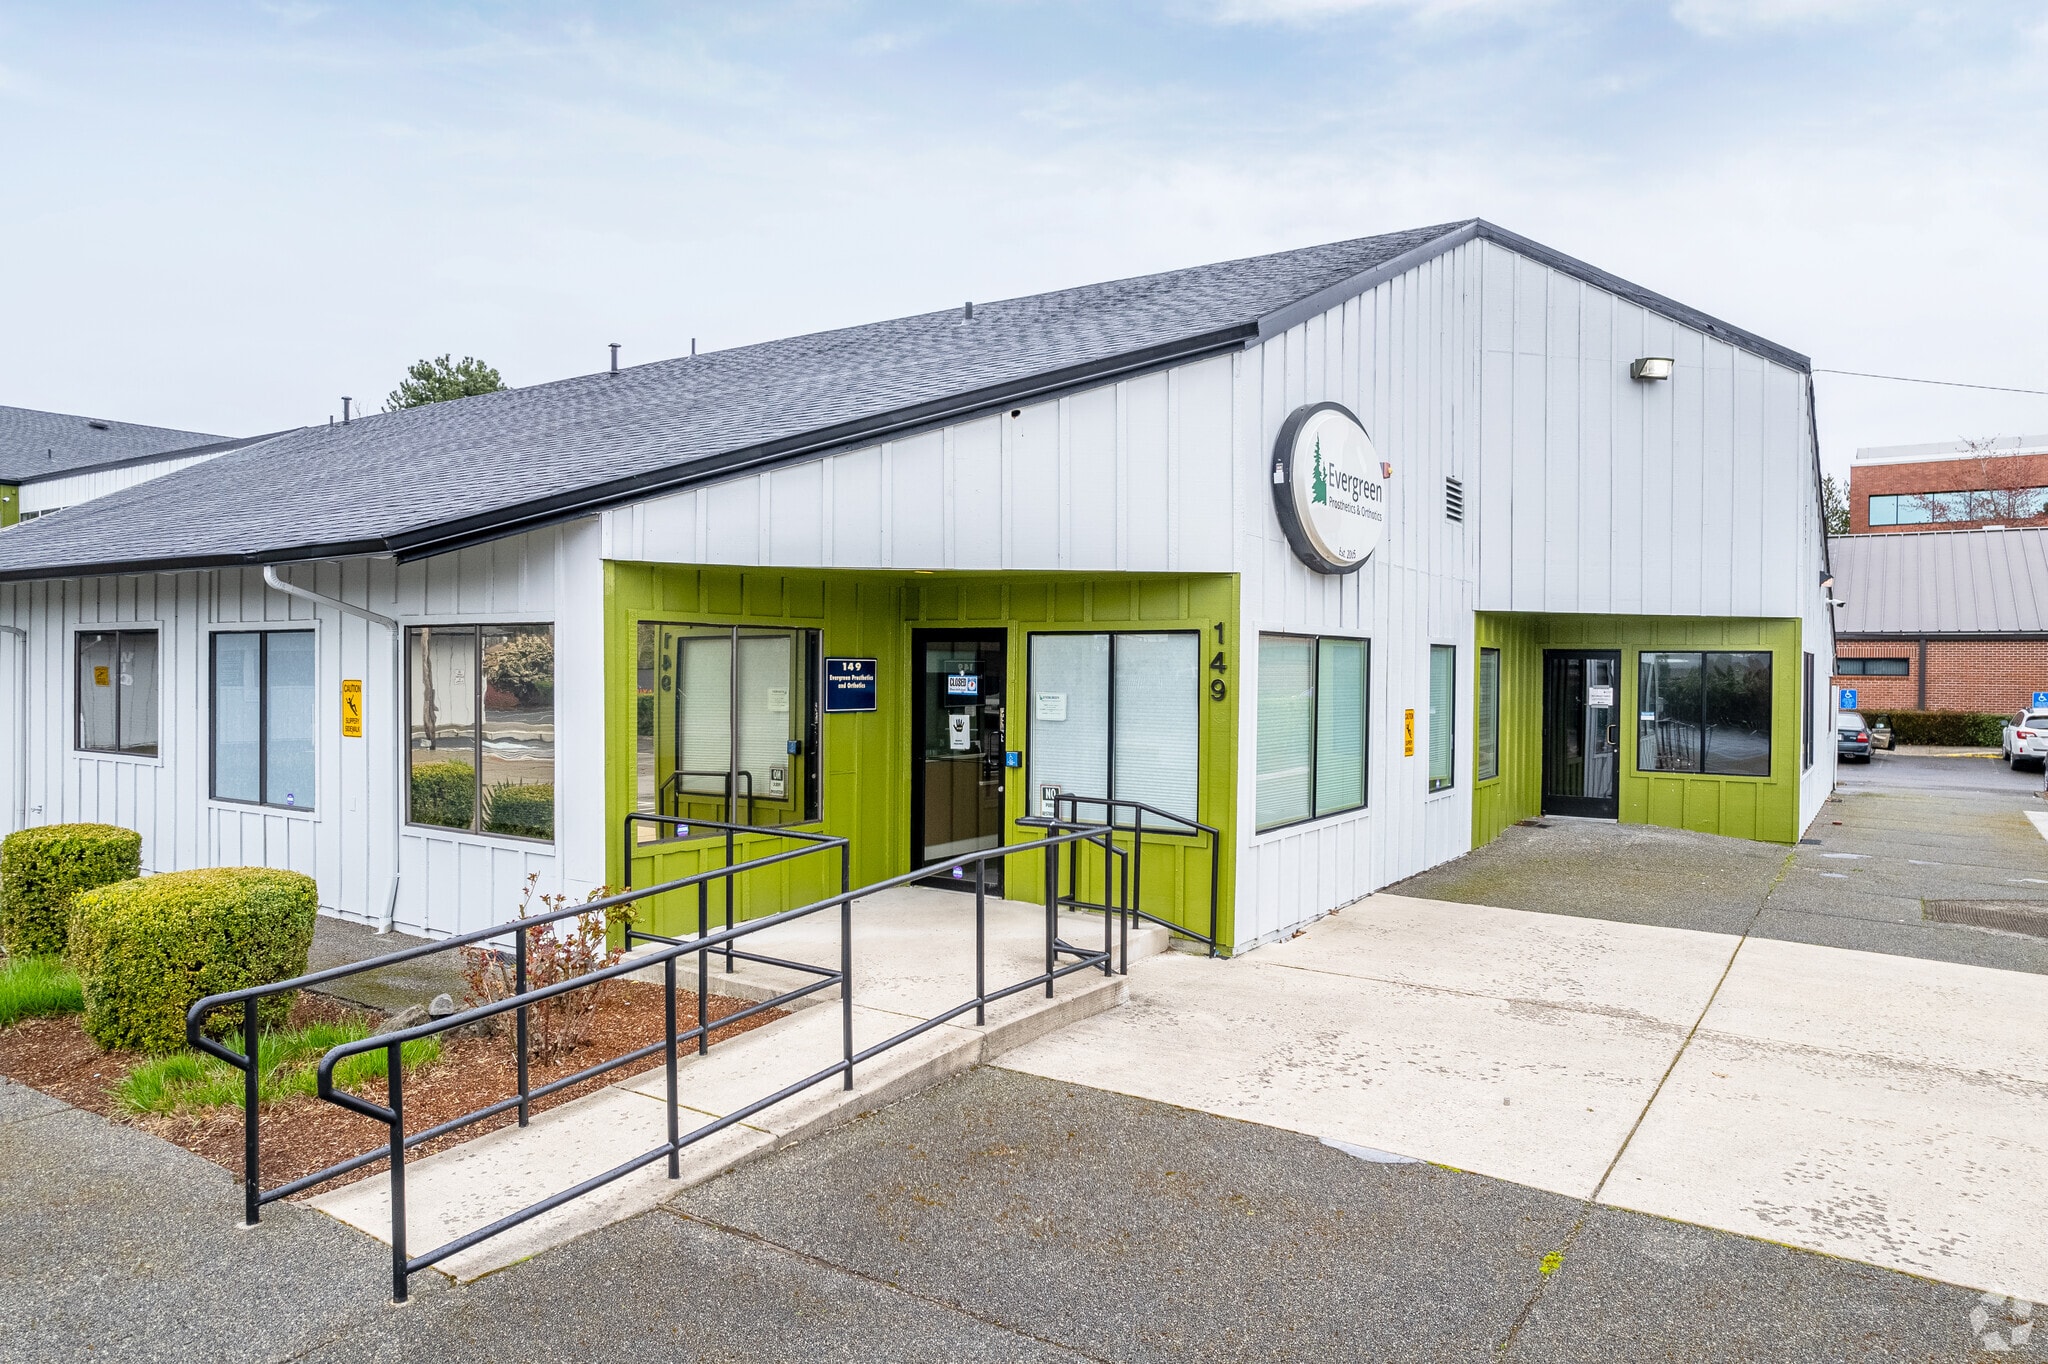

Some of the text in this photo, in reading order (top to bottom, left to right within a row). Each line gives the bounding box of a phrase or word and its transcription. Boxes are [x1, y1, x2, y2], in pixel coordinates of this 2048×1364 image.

[1328, 462, 1382, 503] Evergreen
[1328, 496, 1382, 522] Prosthetics & Orthotics
[842, 662, 862, 671] 149
[1210, 621, 1228, 702] 149
[829, 674, 851, 682] Evergreen
[949, 677, 967, 687] CLOSED
[1046, 788, 1056, 800] NO
